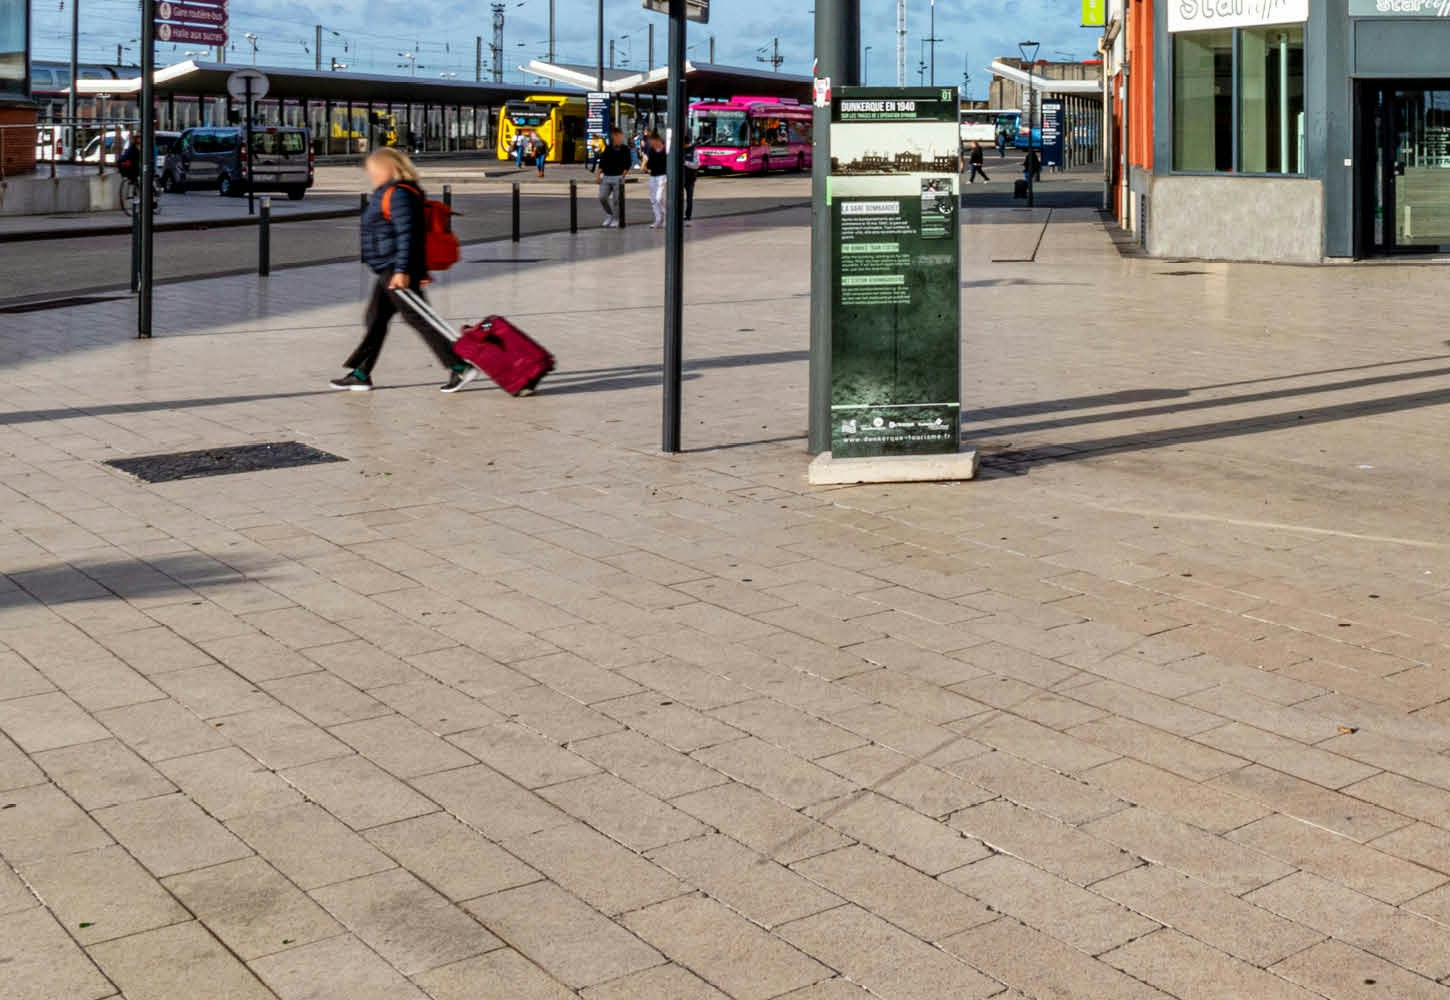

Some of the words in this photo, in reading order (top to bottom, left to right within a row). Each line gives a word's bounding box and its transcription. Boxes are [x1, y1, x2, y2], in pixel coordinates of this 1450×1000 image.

[841, 102, 884, 111] DUNKERQUE
[886, 102, 896, 111] EN
[897, 102, 915, 112] 1940
